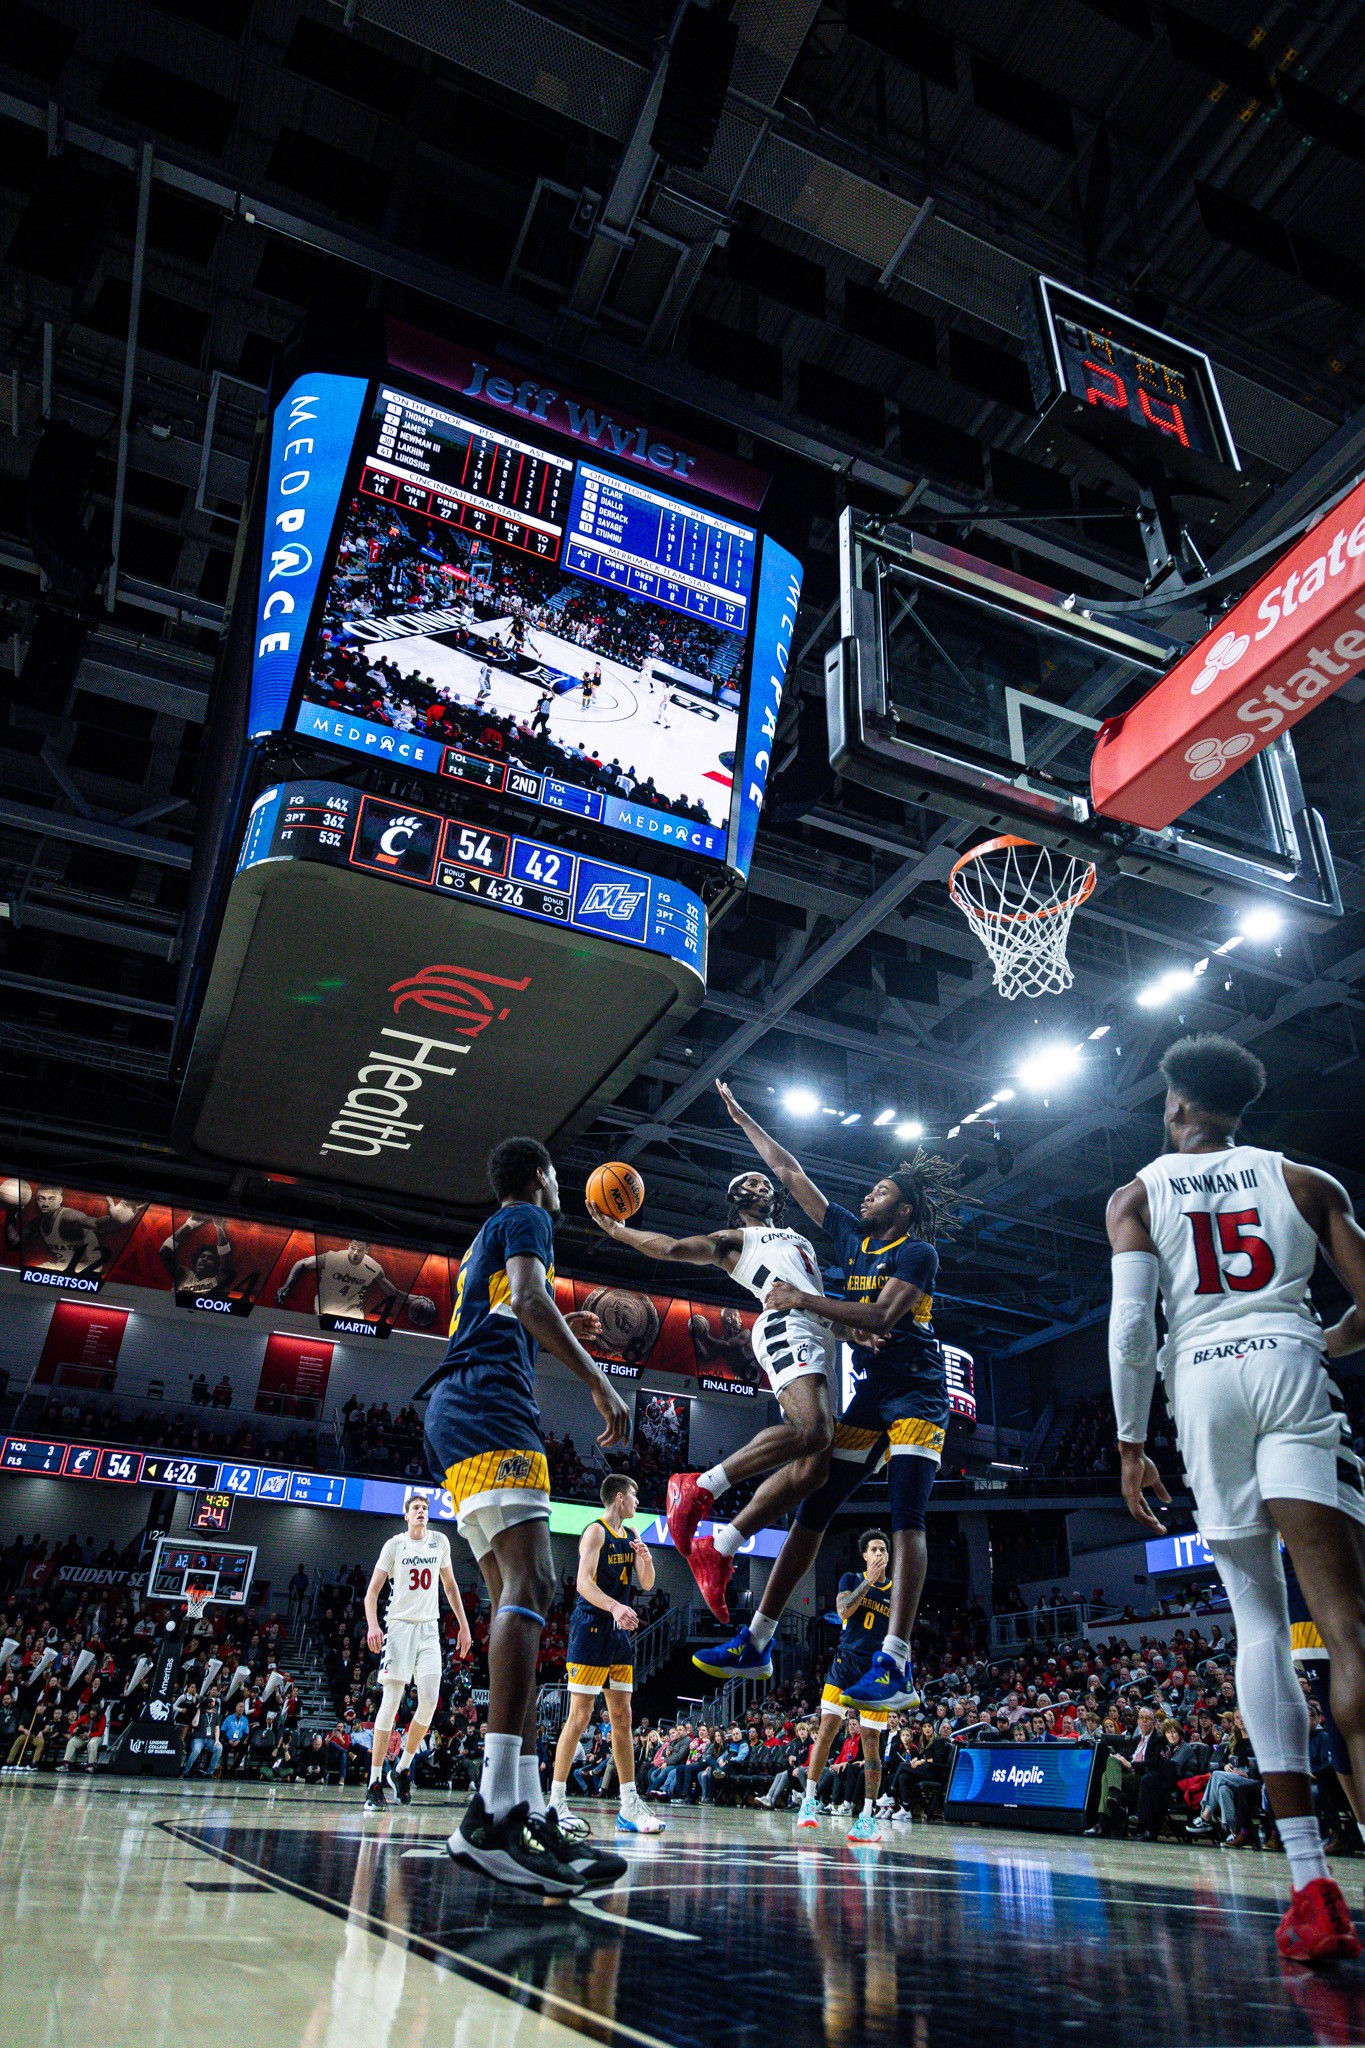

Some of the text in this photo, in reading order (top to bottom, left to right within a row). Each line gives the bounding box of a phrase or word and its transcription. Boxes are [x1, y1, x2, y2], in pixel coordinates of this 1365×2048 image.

[1084, 360, 1190, 448] 24
[392, 395, 544, 458] ON THE FLOOR PTS REB AST
[405, 410, 434, 427] THOMAS
[463, 361, 697, 477] Jeff Wyler
[402, 421, 426, 436] JAMES
[383, 437, 424, 458] 30 LAKHIN
[400, 430, 431, 450] NEWMAN
[433, 443, 441, 453] III
[381, 447, 430, 471] 41 LUKOSIUS
[373, 474, 390, 484] AST
[374, 484, 384, 495] 14
[404, 485, 426, 498] OREB
[410, 473, 522, 520] CINCINNATI TEAM STATS
[602, 486, 623, 500] CLARK
[408, 496, 418, 507] 14
[437, 497, 458, 510] DREB
[590, 472, 605, 482] ON
[608, 479, 620, 488] THE
[625, 484, 652, 500] FLOOR
[691, 511, 705, 521] REB
[714, 520, 727, 530] AST
[600, 497, 623, 511] DIALLO
[440, 508, 452, 518] 27
[473, 511, 486, 520] STL
[599, 507, 628, 524] DERKACK
[258, 396, 320, 658] MEDPACE
[475, 521, 481, 530] 6
[505, 522, 519, 533] BLK
[597, 517, 623, 533] SAVAGE
[507, 532, 513, 541] 5
[538, 534, 548, 543] TO
[596, 527, 622, 543] ETUMNU
[537, 543, 547, 553] 17
[577, 550, 592, 558] AST
[580, 560, 585, 568] 6
[605, 559, 624, 570] OREB
[609, 548, 711, 590] MERRIMACK TEAM STATS
[610, 571, 615, 579] 6
[634, 570, 653, 582] DREB
[1255, 516, 1365, 641] State
[639, 581, 647, 590] 16
[668, 583, 679, 592] STL
[670, 592, 675, 600] 8
[696, 593, 709, 603] BLK
[699, 603, 704, 612] 3
[725, 604, 735, 612] TO
[726, 613, 734, 622] 17
[749, 574, 800, 812] MEDPACE
[314, 718, 424, 760] MEDPACE
[450, 752, 494, 772] TOL 3
[449, 766, 492, 785] FLS 4
[512, 775, 537, 795] 2ND
[550, 783, 591, 802] TOL 1
[290, 796, 348, 812] FG 44%
[550, 796, 590, 814] FLS 8
[285, 813, 345, 829] 3PT 36%
[618, 811, 713, 849] MEDPACE
[281, 831, 341, 847] FT 53%
[458, 829, 492, 866] 54
[444, 867, 466, 879] BONUS
[525, 850, 560, 885] 42
[486, 880, 523, 906] 4:26
[543, 895, 564, 906] BONUS
[658, 892, 671, 902] FG
[656, 909, 673, 920] 3PT
[655, 926, 666, 935] FT
[322, 1028, 472, 1156] Health
[1168, 1168, 1259, 1195] NEWMAN III
[611, 1188, 627, 1213] NCAA
[1180, 1207, 1276, 1295] 15
[24, 1270, 99, 1292] ROBERTSON
[195, 1298, 232, 1312] COOK
[334, 1320, 377, 1335] MARTIN
[1193, 1338, 1277, 1365] BEARCATS
[610, 1364, 638, 1377] EIGHT
[703, 1380, 754, 1396] FINAL FOUR
[11, 1442, 54, 1456] TOL 3
[7, 1456, 50, 1469] FLS 4
[107, 1454, 131, 1477] 54
[163, 1462, 196, 1484] 4:26
[227, 1469, 251, 1492] 42
[297, 1476, 334, 1489] TOL 1
[206, 1493, 230, 1507] 4:26
[295, 1491, 332, 1502] FLS 8
[198, 1506, 224, 1526] 24
[402, 1556, 437, 1565] CINCINNATI
[58, 1566, 129, 1584] STUDENT
[409, 1568, 431, 1590] 30
[619, 1566, 628, 1585] 4
[864, 1611, 875, 1630] 0
[159, 1657, 174, 1696] Ameritas
[1007, 1765, 1044, 1787] Applic
